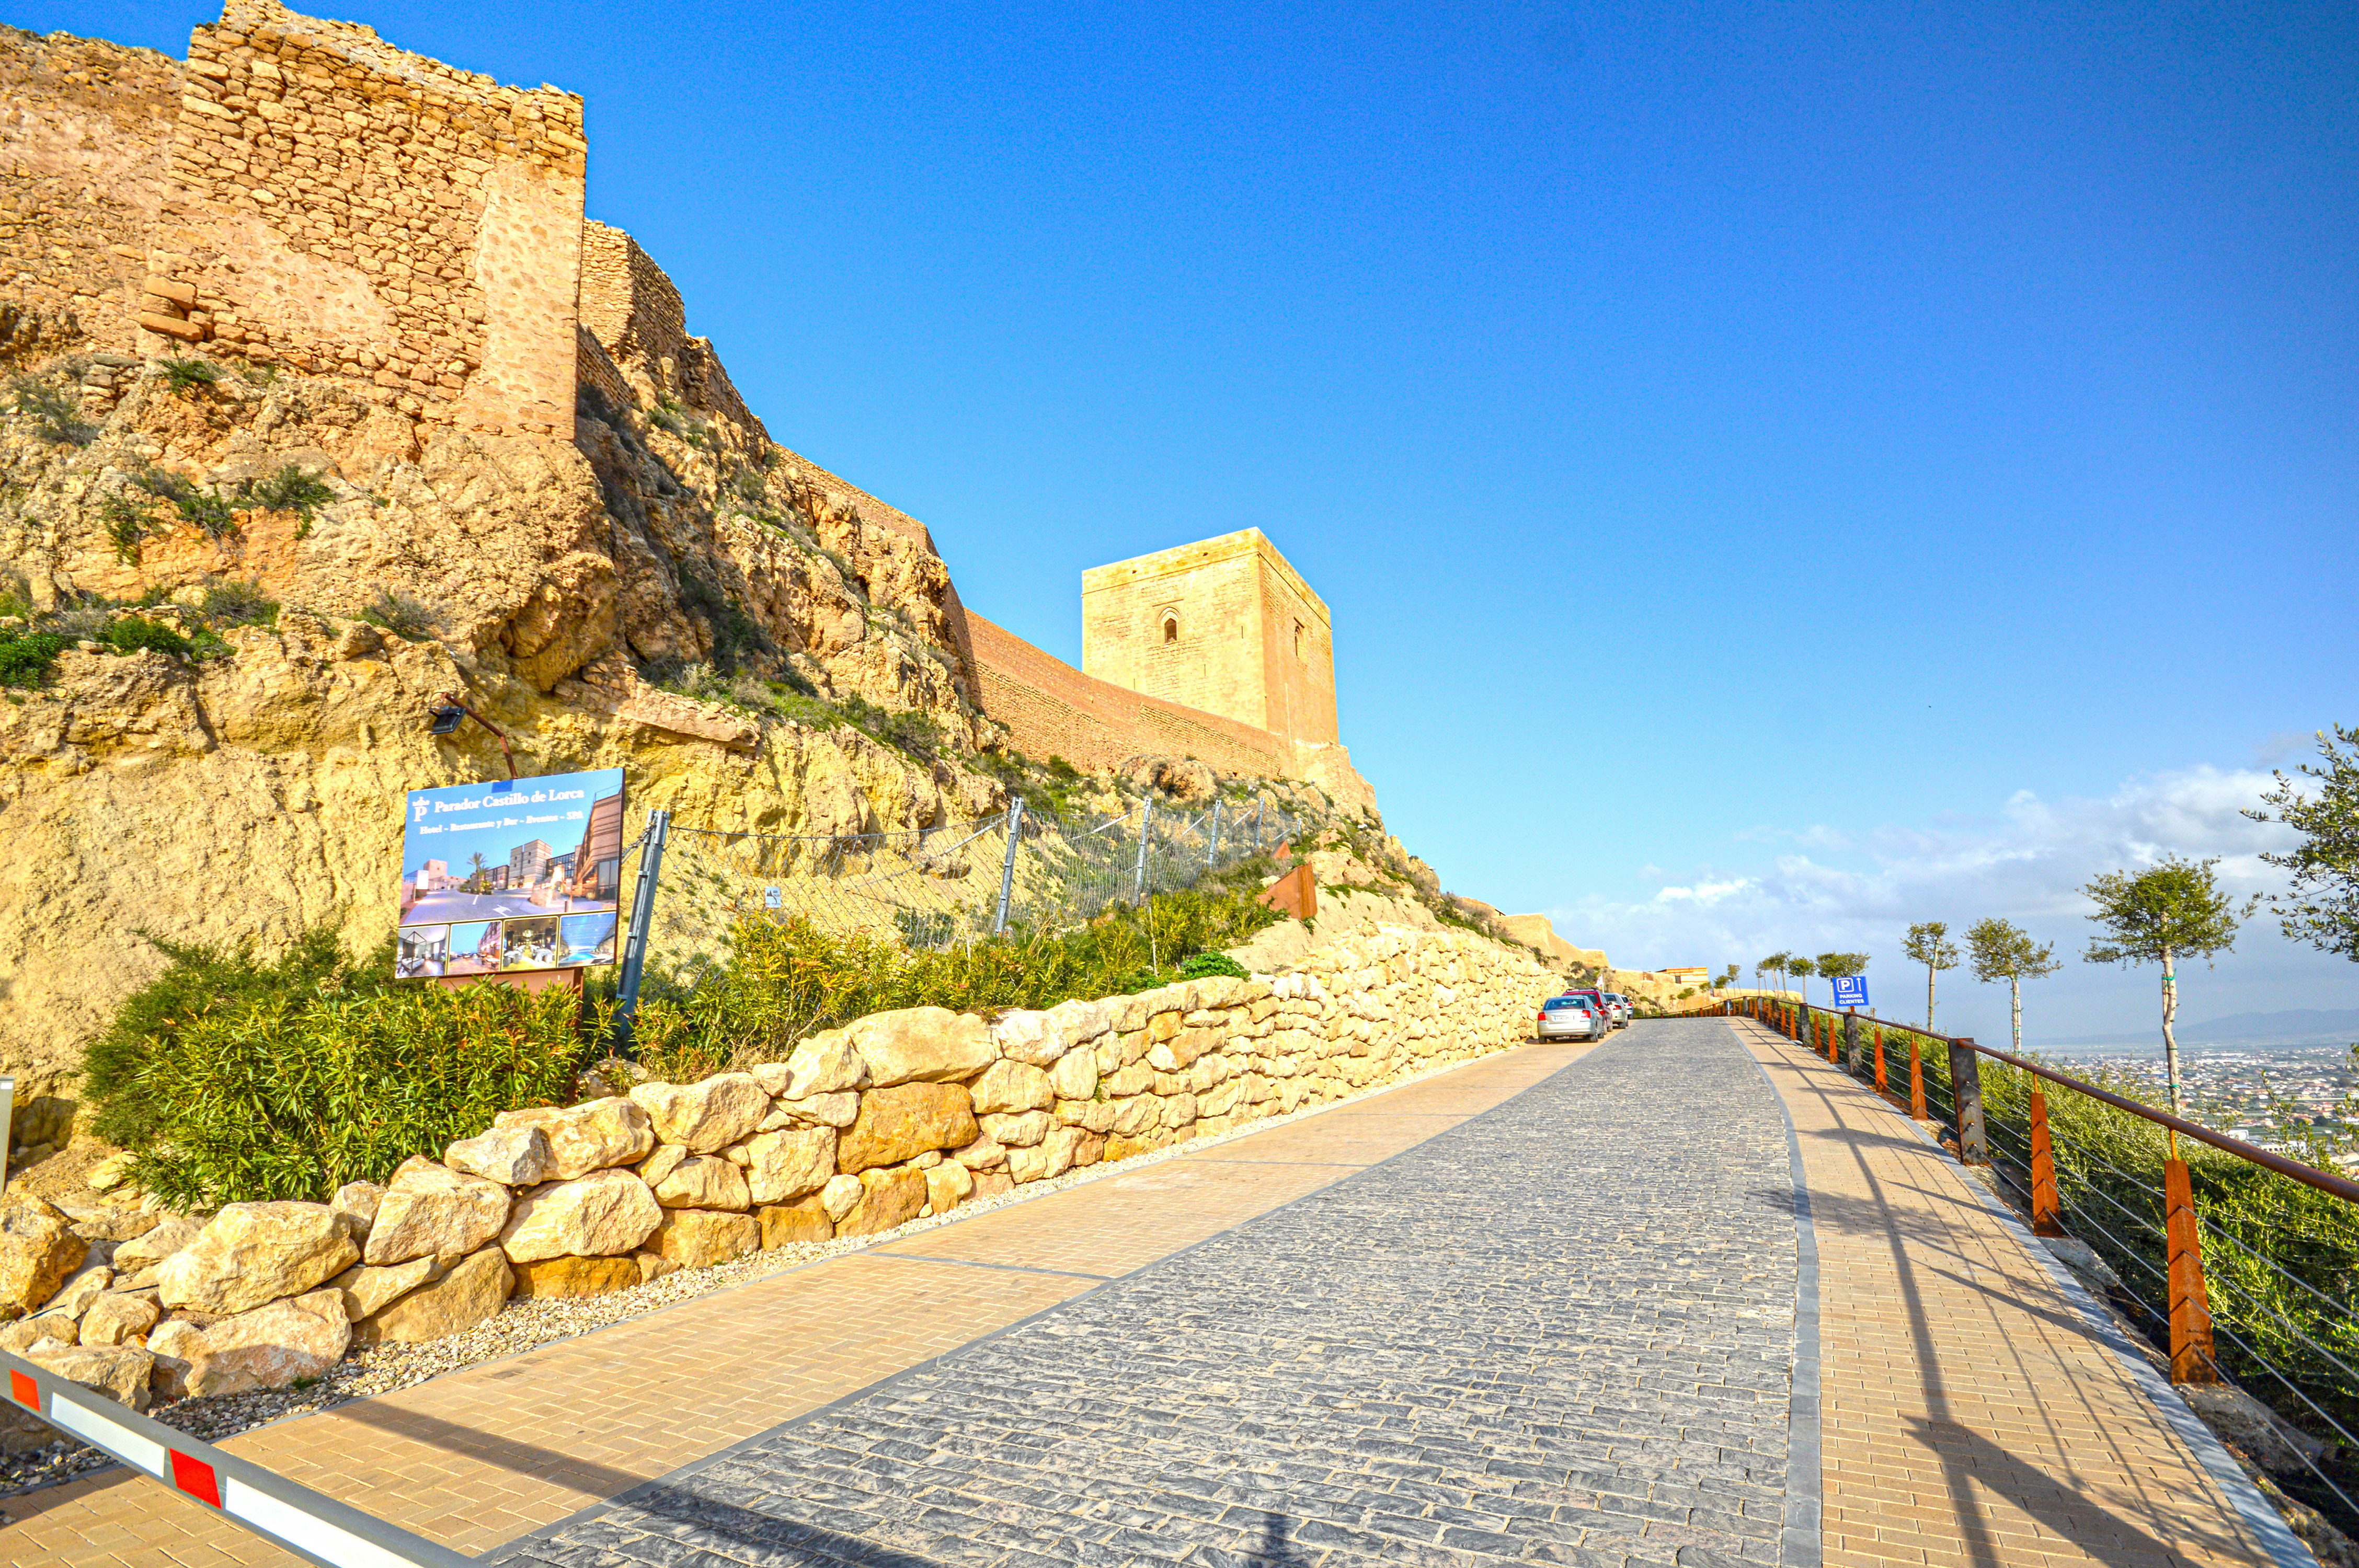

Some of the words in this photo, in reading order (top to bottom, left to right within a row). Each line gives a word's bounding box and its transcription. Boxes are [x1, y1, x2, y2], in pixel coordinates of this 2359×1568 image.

[434, 798, 480, 813] Parador
[483, 792, 529, 807] Castillo
[531, 790, 546, 803] de
[548, 789, 585, 801] Lorca
[420, 825, 442, 834] Hotel
[450, 821, 495, 831] Restaurante
[503, 817, 518, 826] Bar
[567, 811, 584, 820] SPA
[1841, 980, 1850, 990] P
